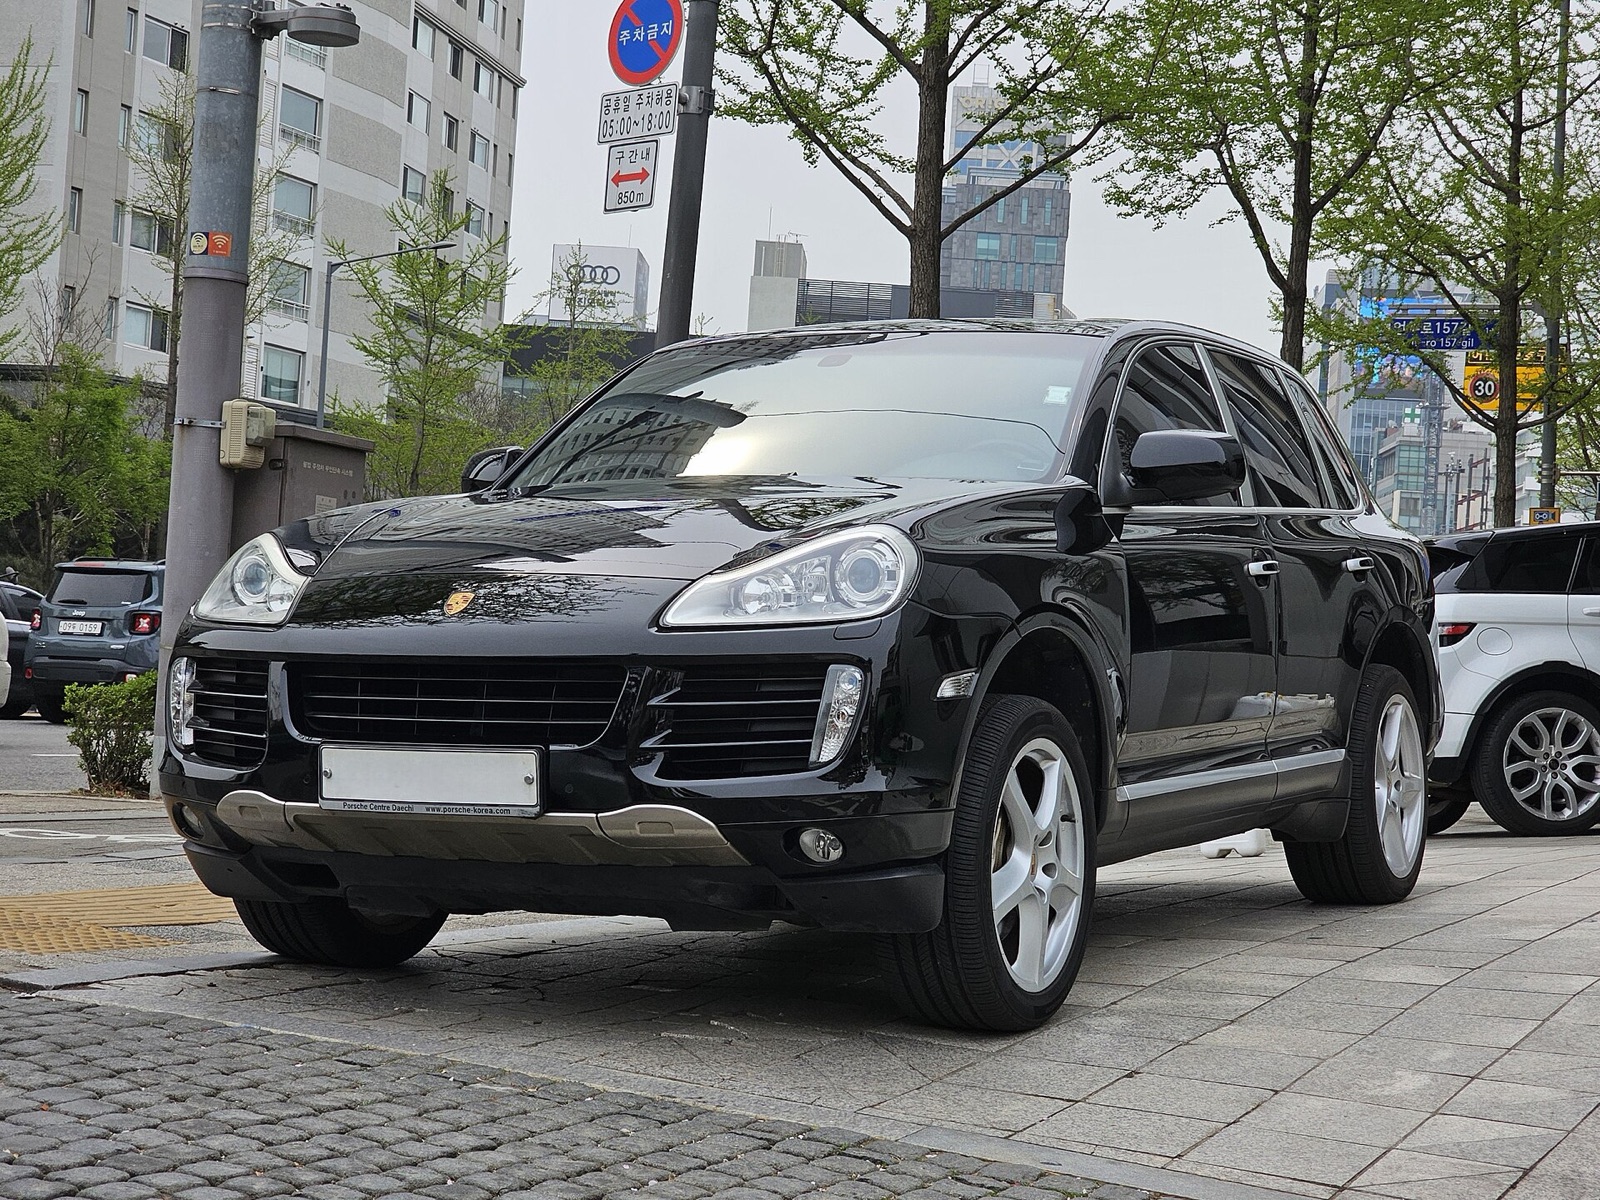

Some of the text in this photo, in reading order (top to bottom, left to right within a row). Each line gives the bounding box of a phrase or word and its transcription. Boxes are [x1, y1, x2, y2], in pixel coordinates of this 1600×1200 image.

[619, 20, 673, 46] 주차금지
[603, 88, 673, 116] 공휴일 주차허용
[602, 110, 671, 139] 05:00~18:00
[617, 190, 644, 205] 850m
[1475, 381, 1495, 396] 30
[79, 623, 98, 632] 0159
[342, 802, 511, 815] Porsche Centre Daechi www.porsche-korea.com
